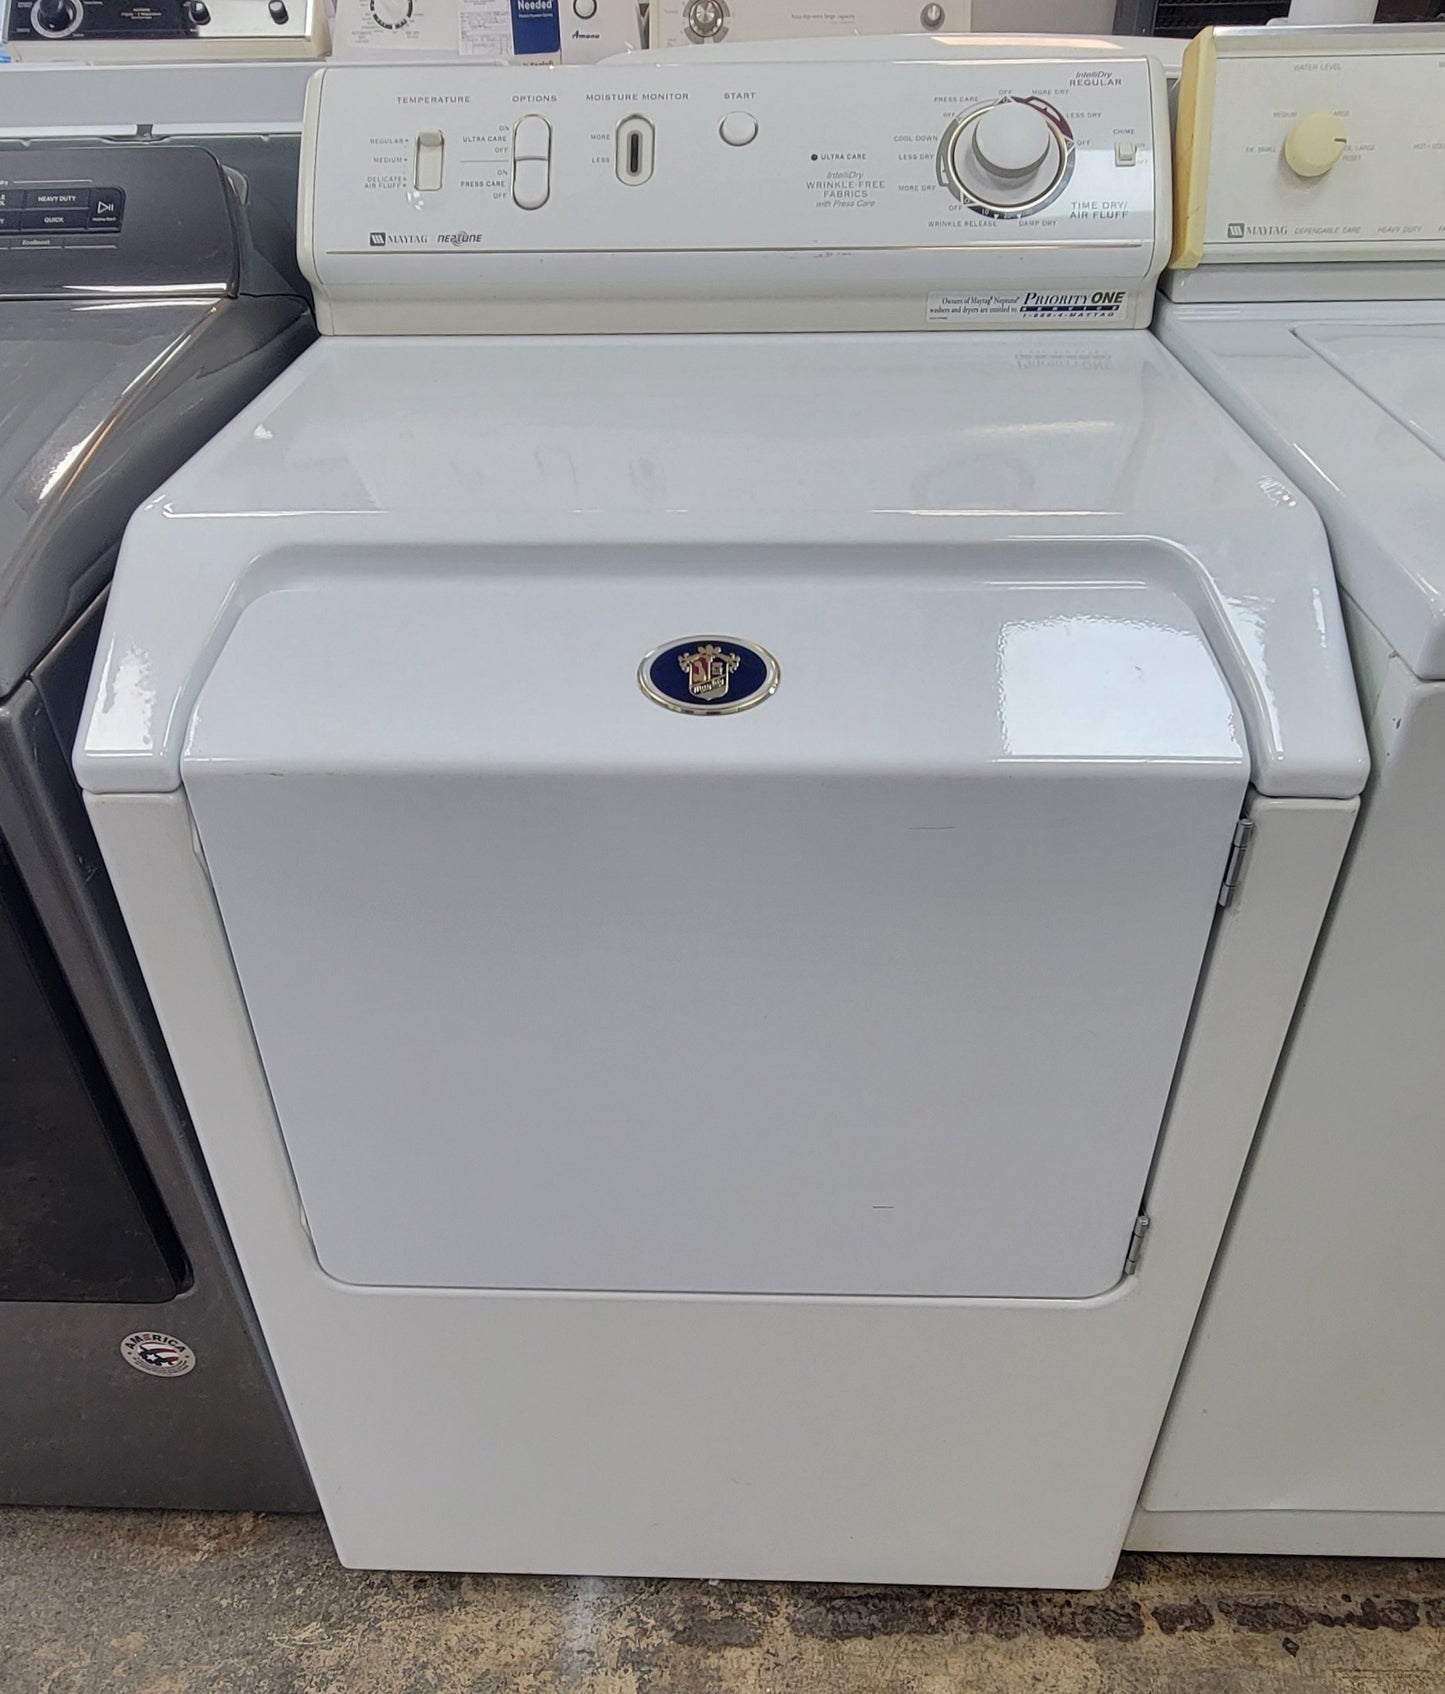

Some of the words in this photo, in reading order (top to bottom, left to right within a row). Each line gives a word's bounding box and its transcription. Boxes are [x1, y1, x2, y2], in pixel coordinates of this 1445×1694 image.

[572, 30, 600, 39] Amana
[1321, 63, 1342, 71] LEVEL
[396, 95, 471, 104] TEMPERATURE
[512, 95, 557, 103] OPTIONS
[586, 93, 638, 101] MOISTURE
[724, 92, 757, 100] START
[460, 180, 484, 188] PRESS
[806, 180, 886, 189] WRINKLE-FREE
[823, 190, 868, 198] FABRICS
[1071, 201, 1098, 210] TIME
[1102, 201, 1128, 210] DRY/
[1069, 211, 1088, 219] AIR
[1093, 210, 1129, 219] FLUFF
[1247, 225, 1288, 236] MAYTAG
[1377, 225, 1400, 233] HEAVY
[1402, 225, 1422, 233] DUTY
[387, 235, 428, 243] MAYTAG
[1091, 291, 1126, 304] ONE
[125, 1333, 186, 1353] AMERICA
